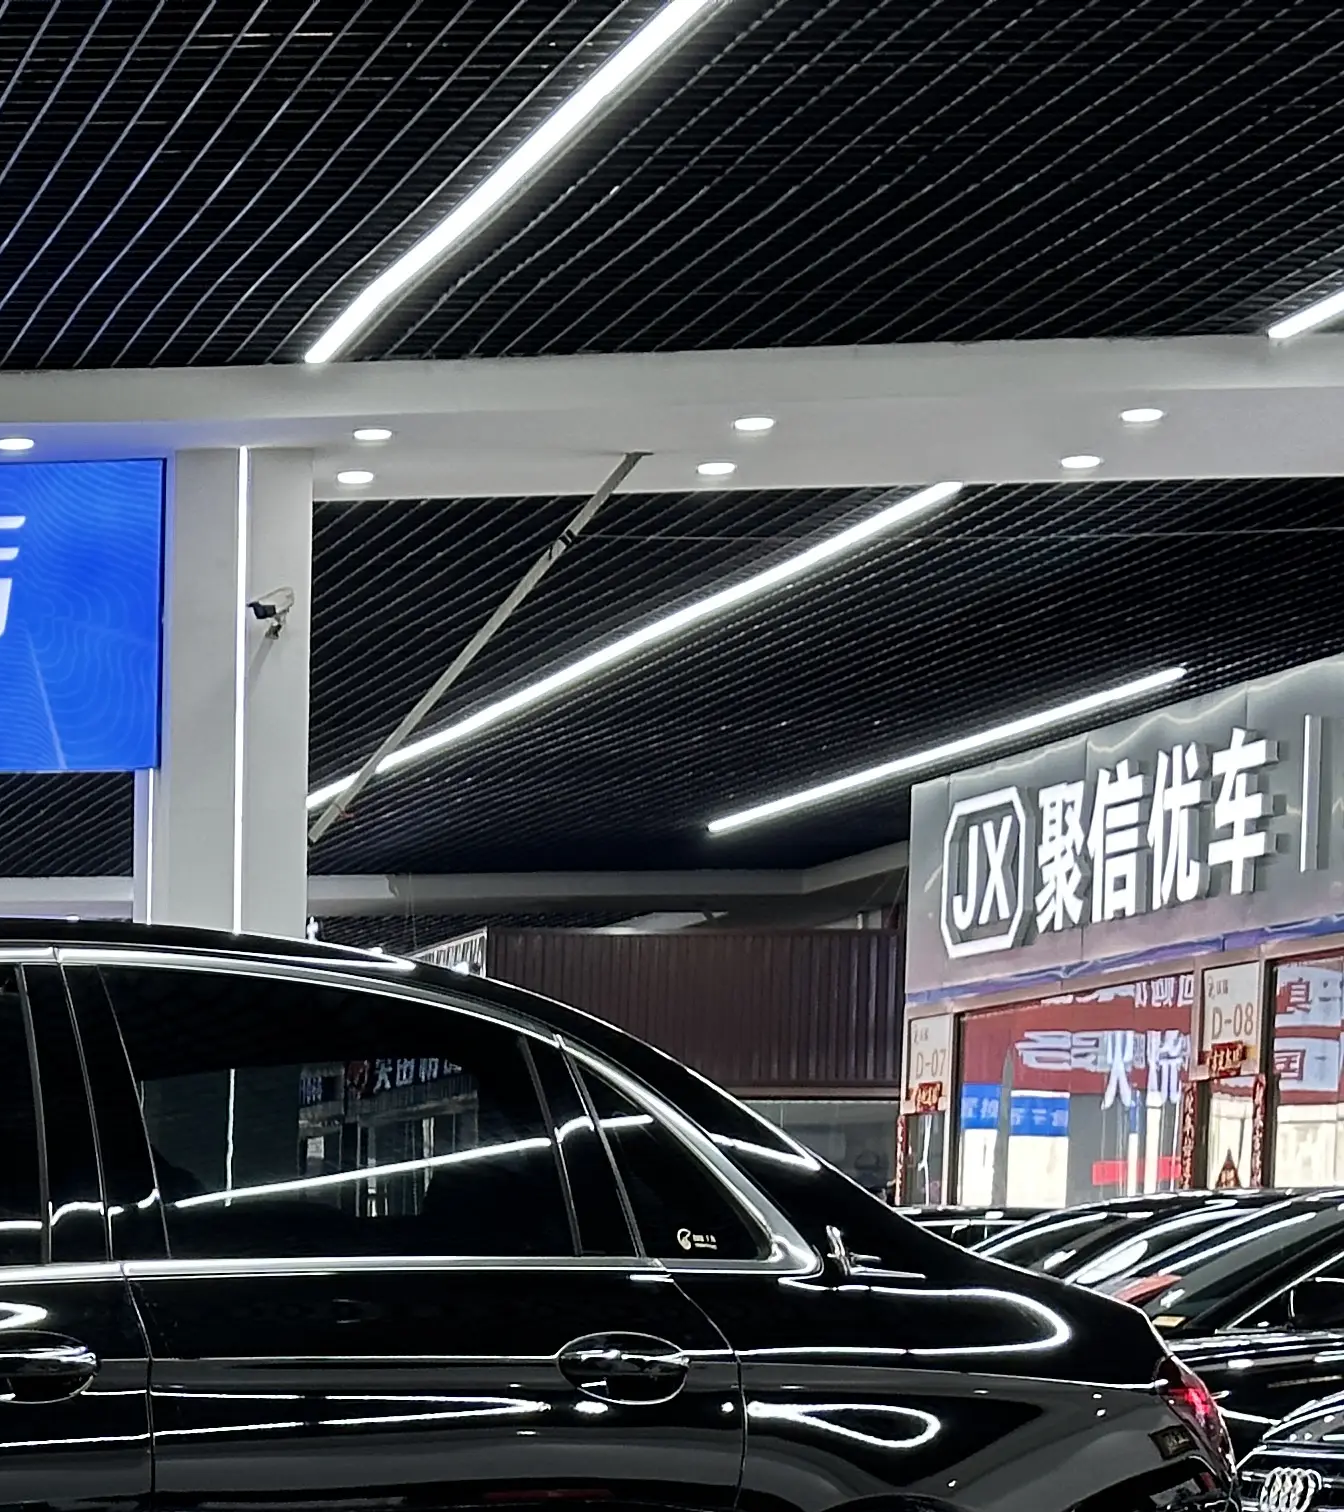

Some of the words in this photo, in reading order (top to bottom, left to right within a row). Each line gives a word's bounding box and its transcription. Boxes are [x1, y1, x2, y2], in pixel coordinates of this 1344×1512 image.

[1034, 727, 1272, 933] 聚信优车
[1212, 1003, 1254, 1040] D-08
[915, 1043, 947, 1080] D-07
